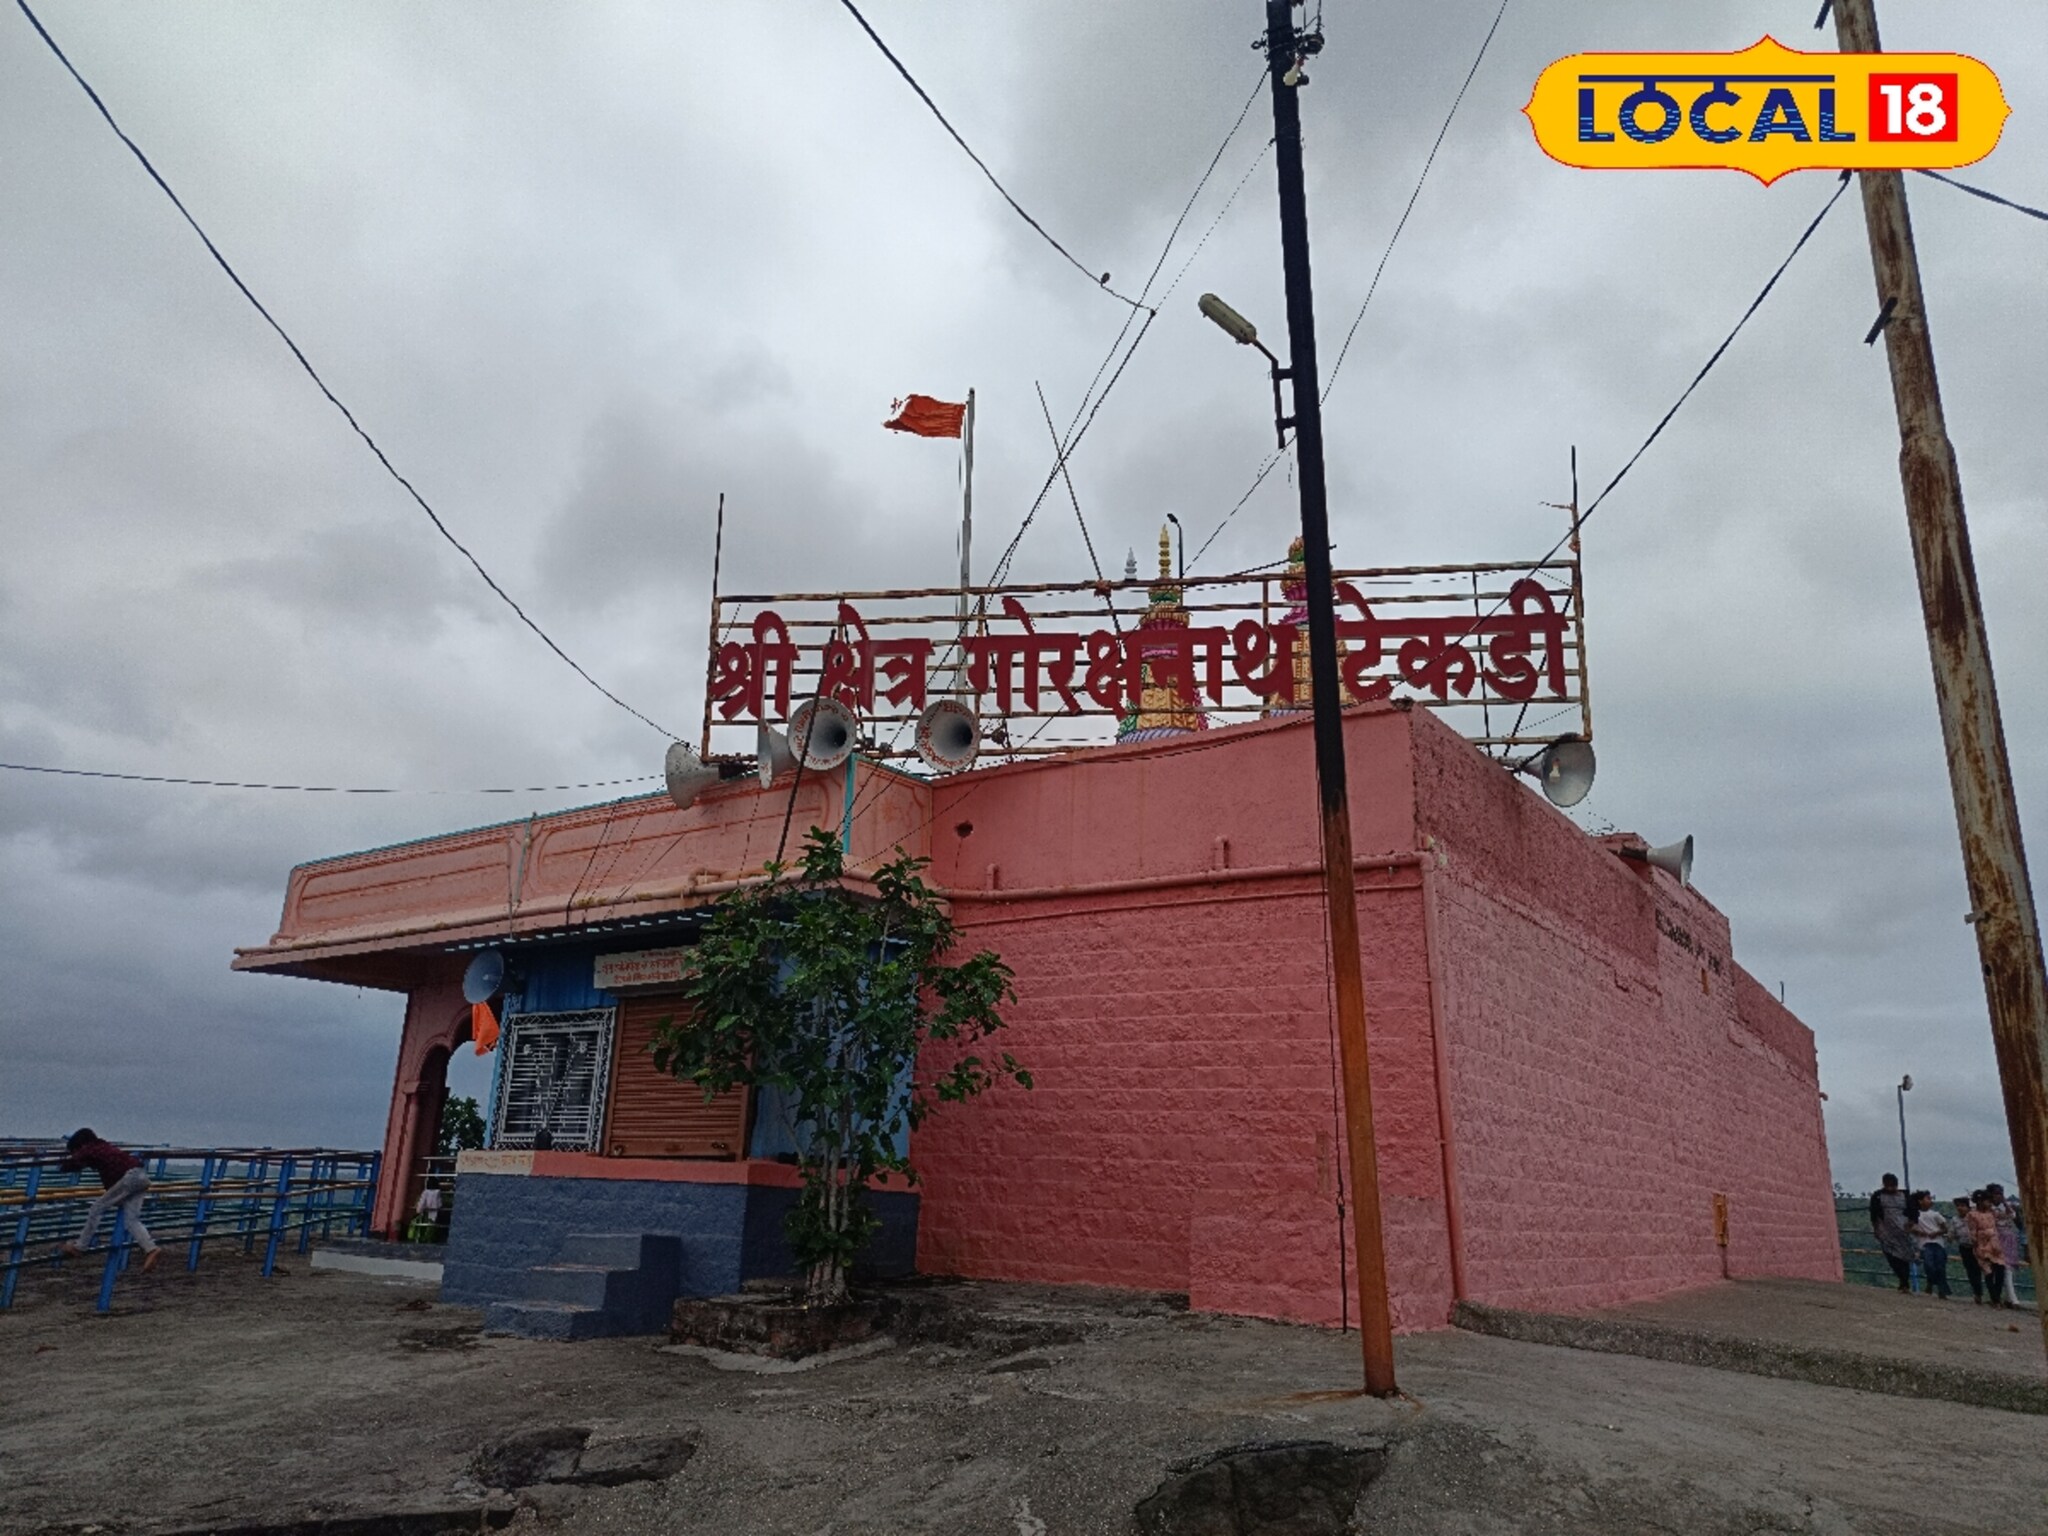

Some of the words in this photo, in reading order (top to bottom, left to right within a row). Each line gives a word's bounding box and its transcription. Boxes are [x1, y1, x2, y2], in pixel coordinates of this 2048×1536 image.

[709, 611, 800, 720] श्री
[819, 603, 935, 715] क्षेत्र
[961, 596, 1302, 722] गोरक्षनाथ
[1334, 578, 1570, 700] टेकडी
